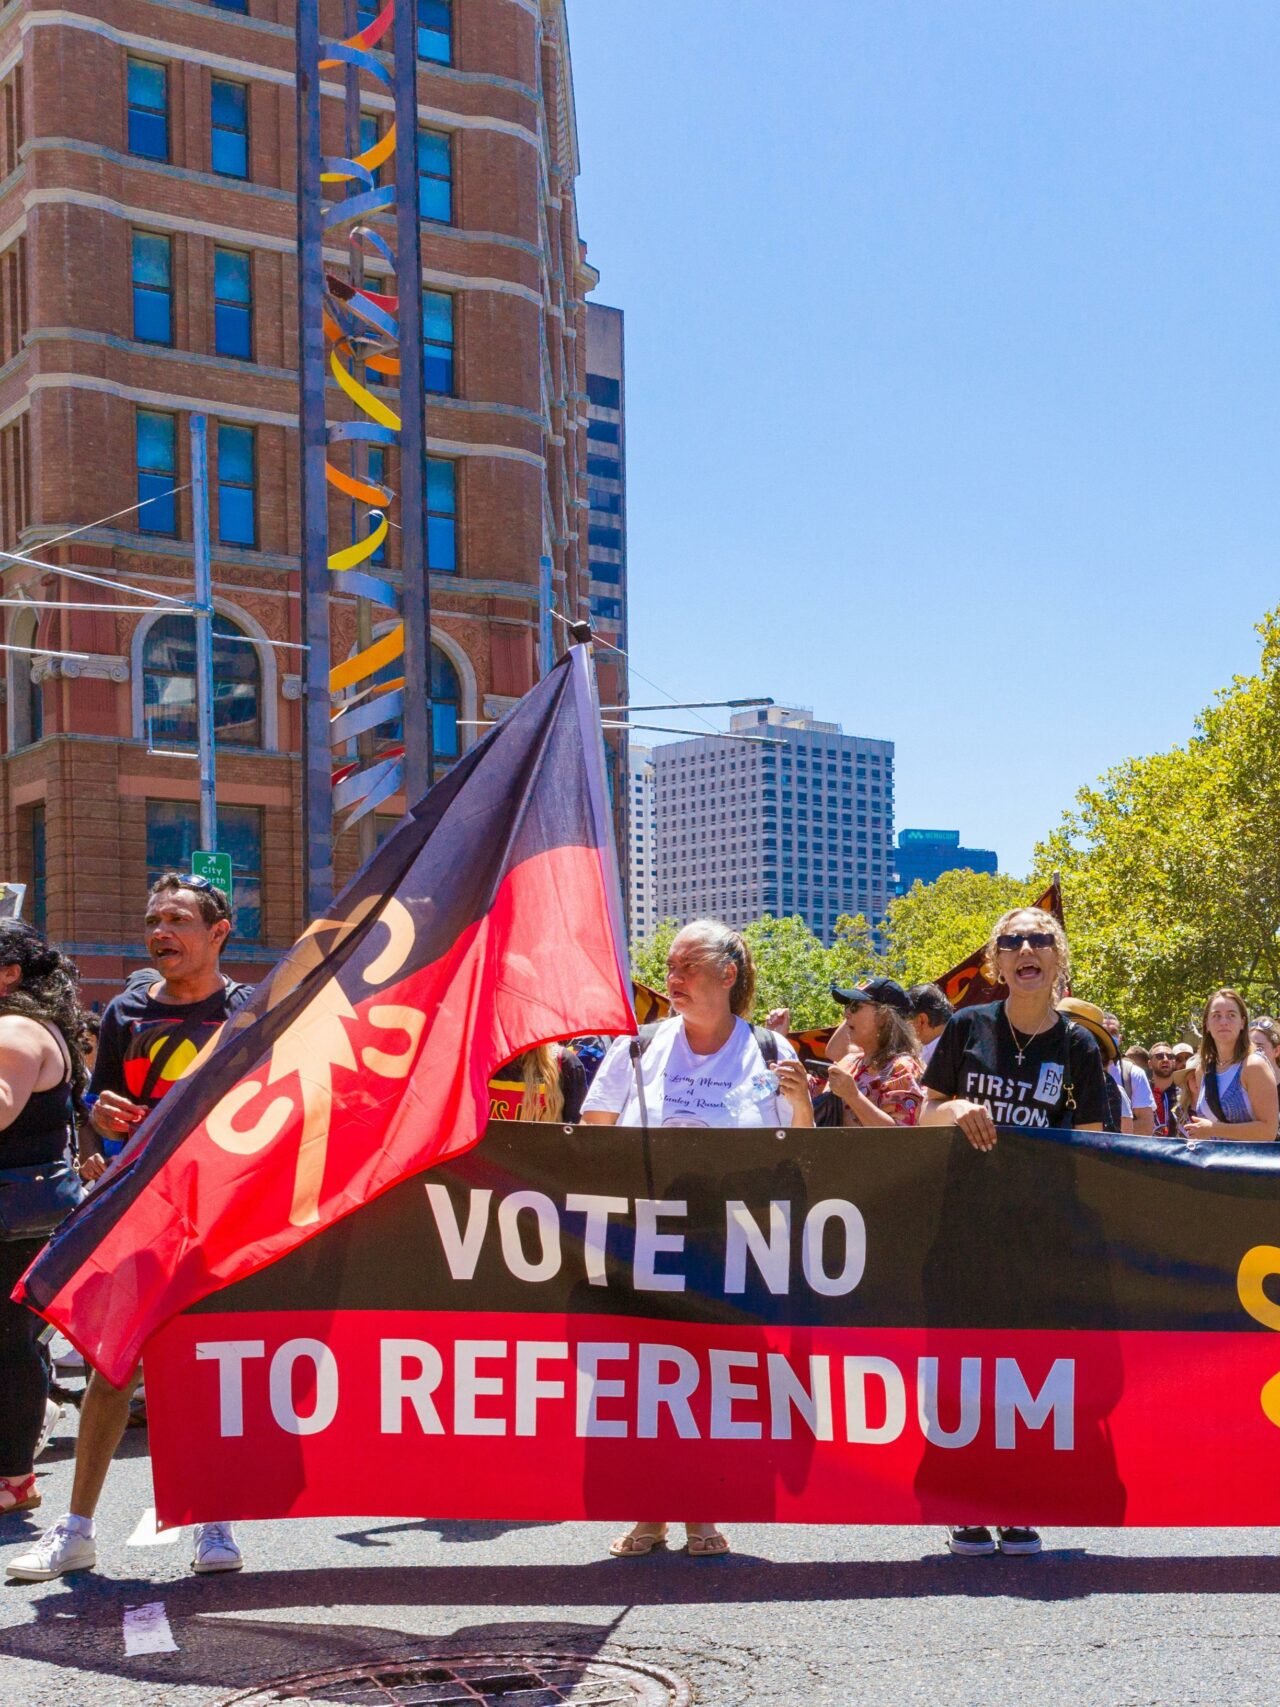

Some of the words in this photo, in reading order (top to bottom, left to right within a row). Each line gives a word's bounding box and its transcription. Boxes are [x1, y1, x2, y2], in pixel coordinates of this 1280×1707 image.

[201, 866, 222, 876] City
[206, 877, 226, 885] orth
[698, 1077, 733, 1089] Memory
[1045, 1069, 1062, 1085] FN
[686, 1088, 695, 1096] of
[966, 1071, 1033, 1101] FIRST
[1042, 1082, 1059, 1097] FD
[966, 1097, 1050, 1128] ATION
[425, 1184, 688, 1292] VOTE
[725, 1199, 867, 1297] NO
[195, 1338, 339, 1437] TO
[380, 1338, 1075, 1452] REFERENDUM
